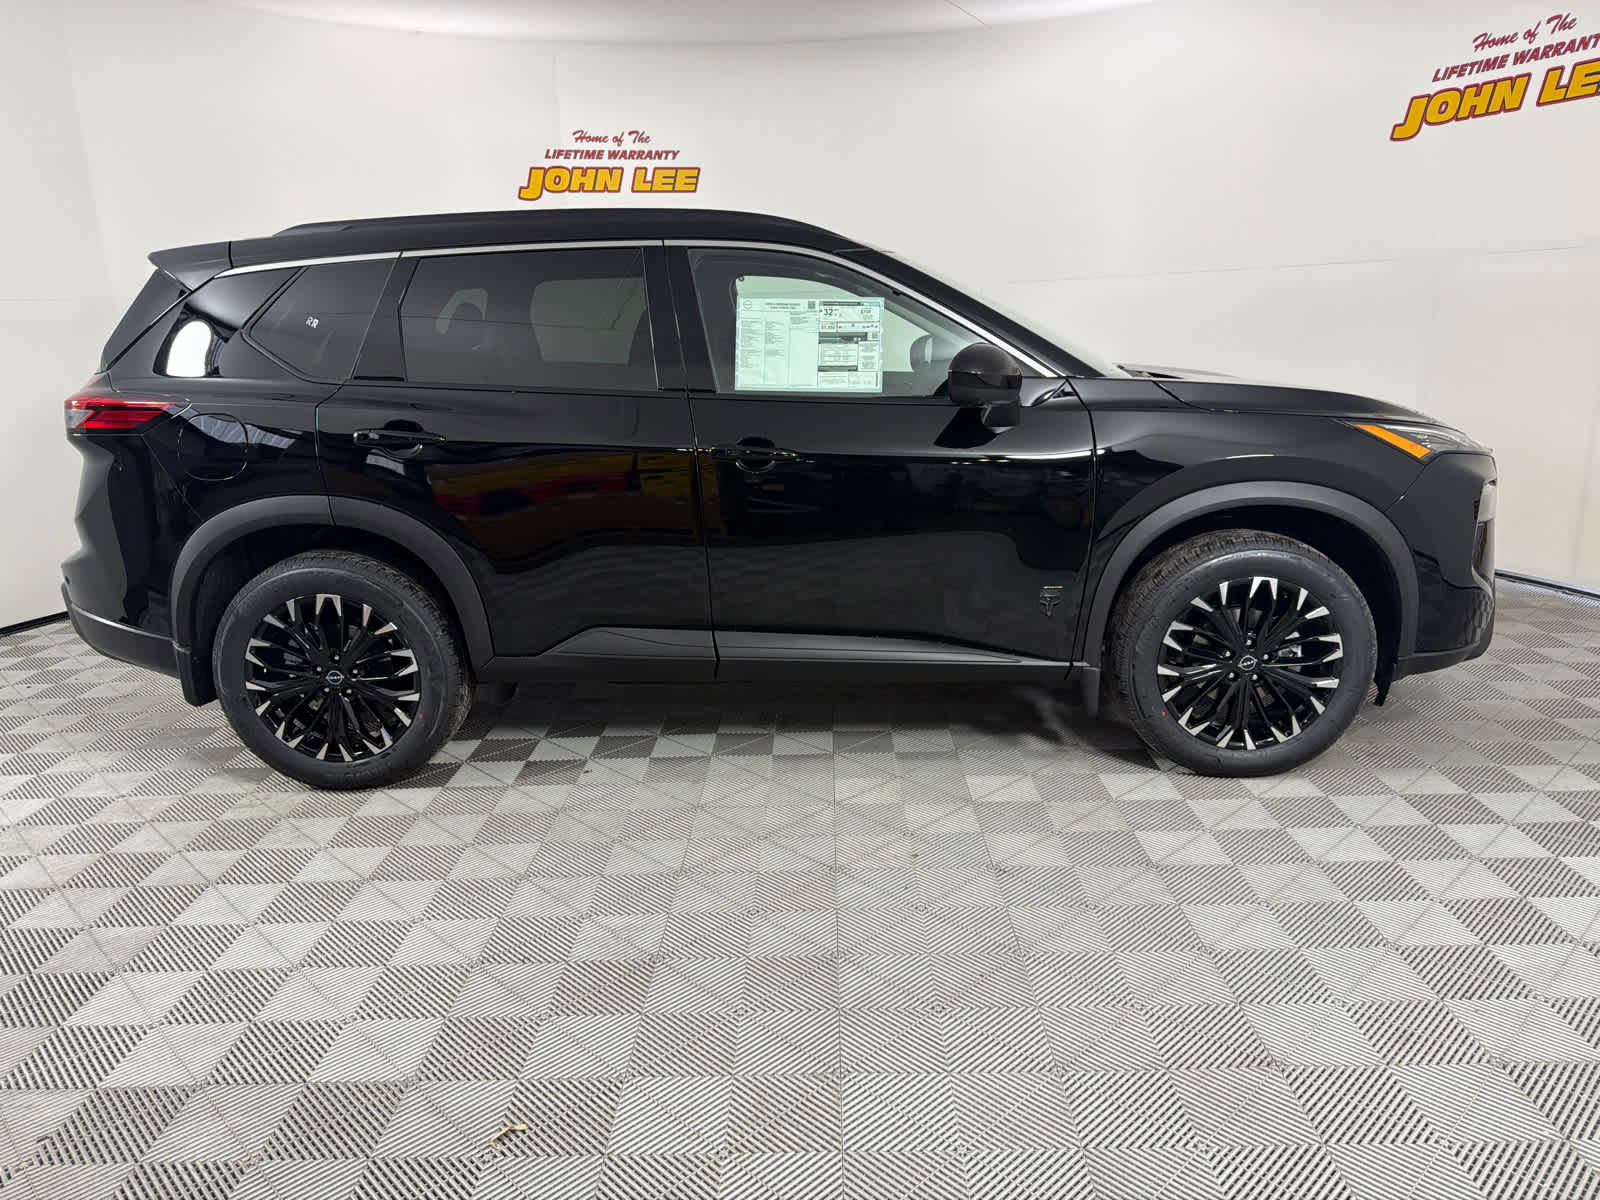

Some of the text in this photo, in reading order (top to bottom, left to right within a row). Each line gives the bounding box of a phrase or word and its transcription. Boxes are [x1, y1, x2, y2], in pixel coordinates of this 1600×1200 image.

[1472, 12, 1577, 52] Home of The
[1432, 32, 1600, 83] LIFETIME WARRANT
[1390, 56, 1600, 142] JOHN LE
[544, 149, 680, 160] LIFETIME WARRANTY
[572, 130, 651, 147] Home of The
[518, 166, 701, 201] JOHN LEE
[824, 308, 833, 316] 32
